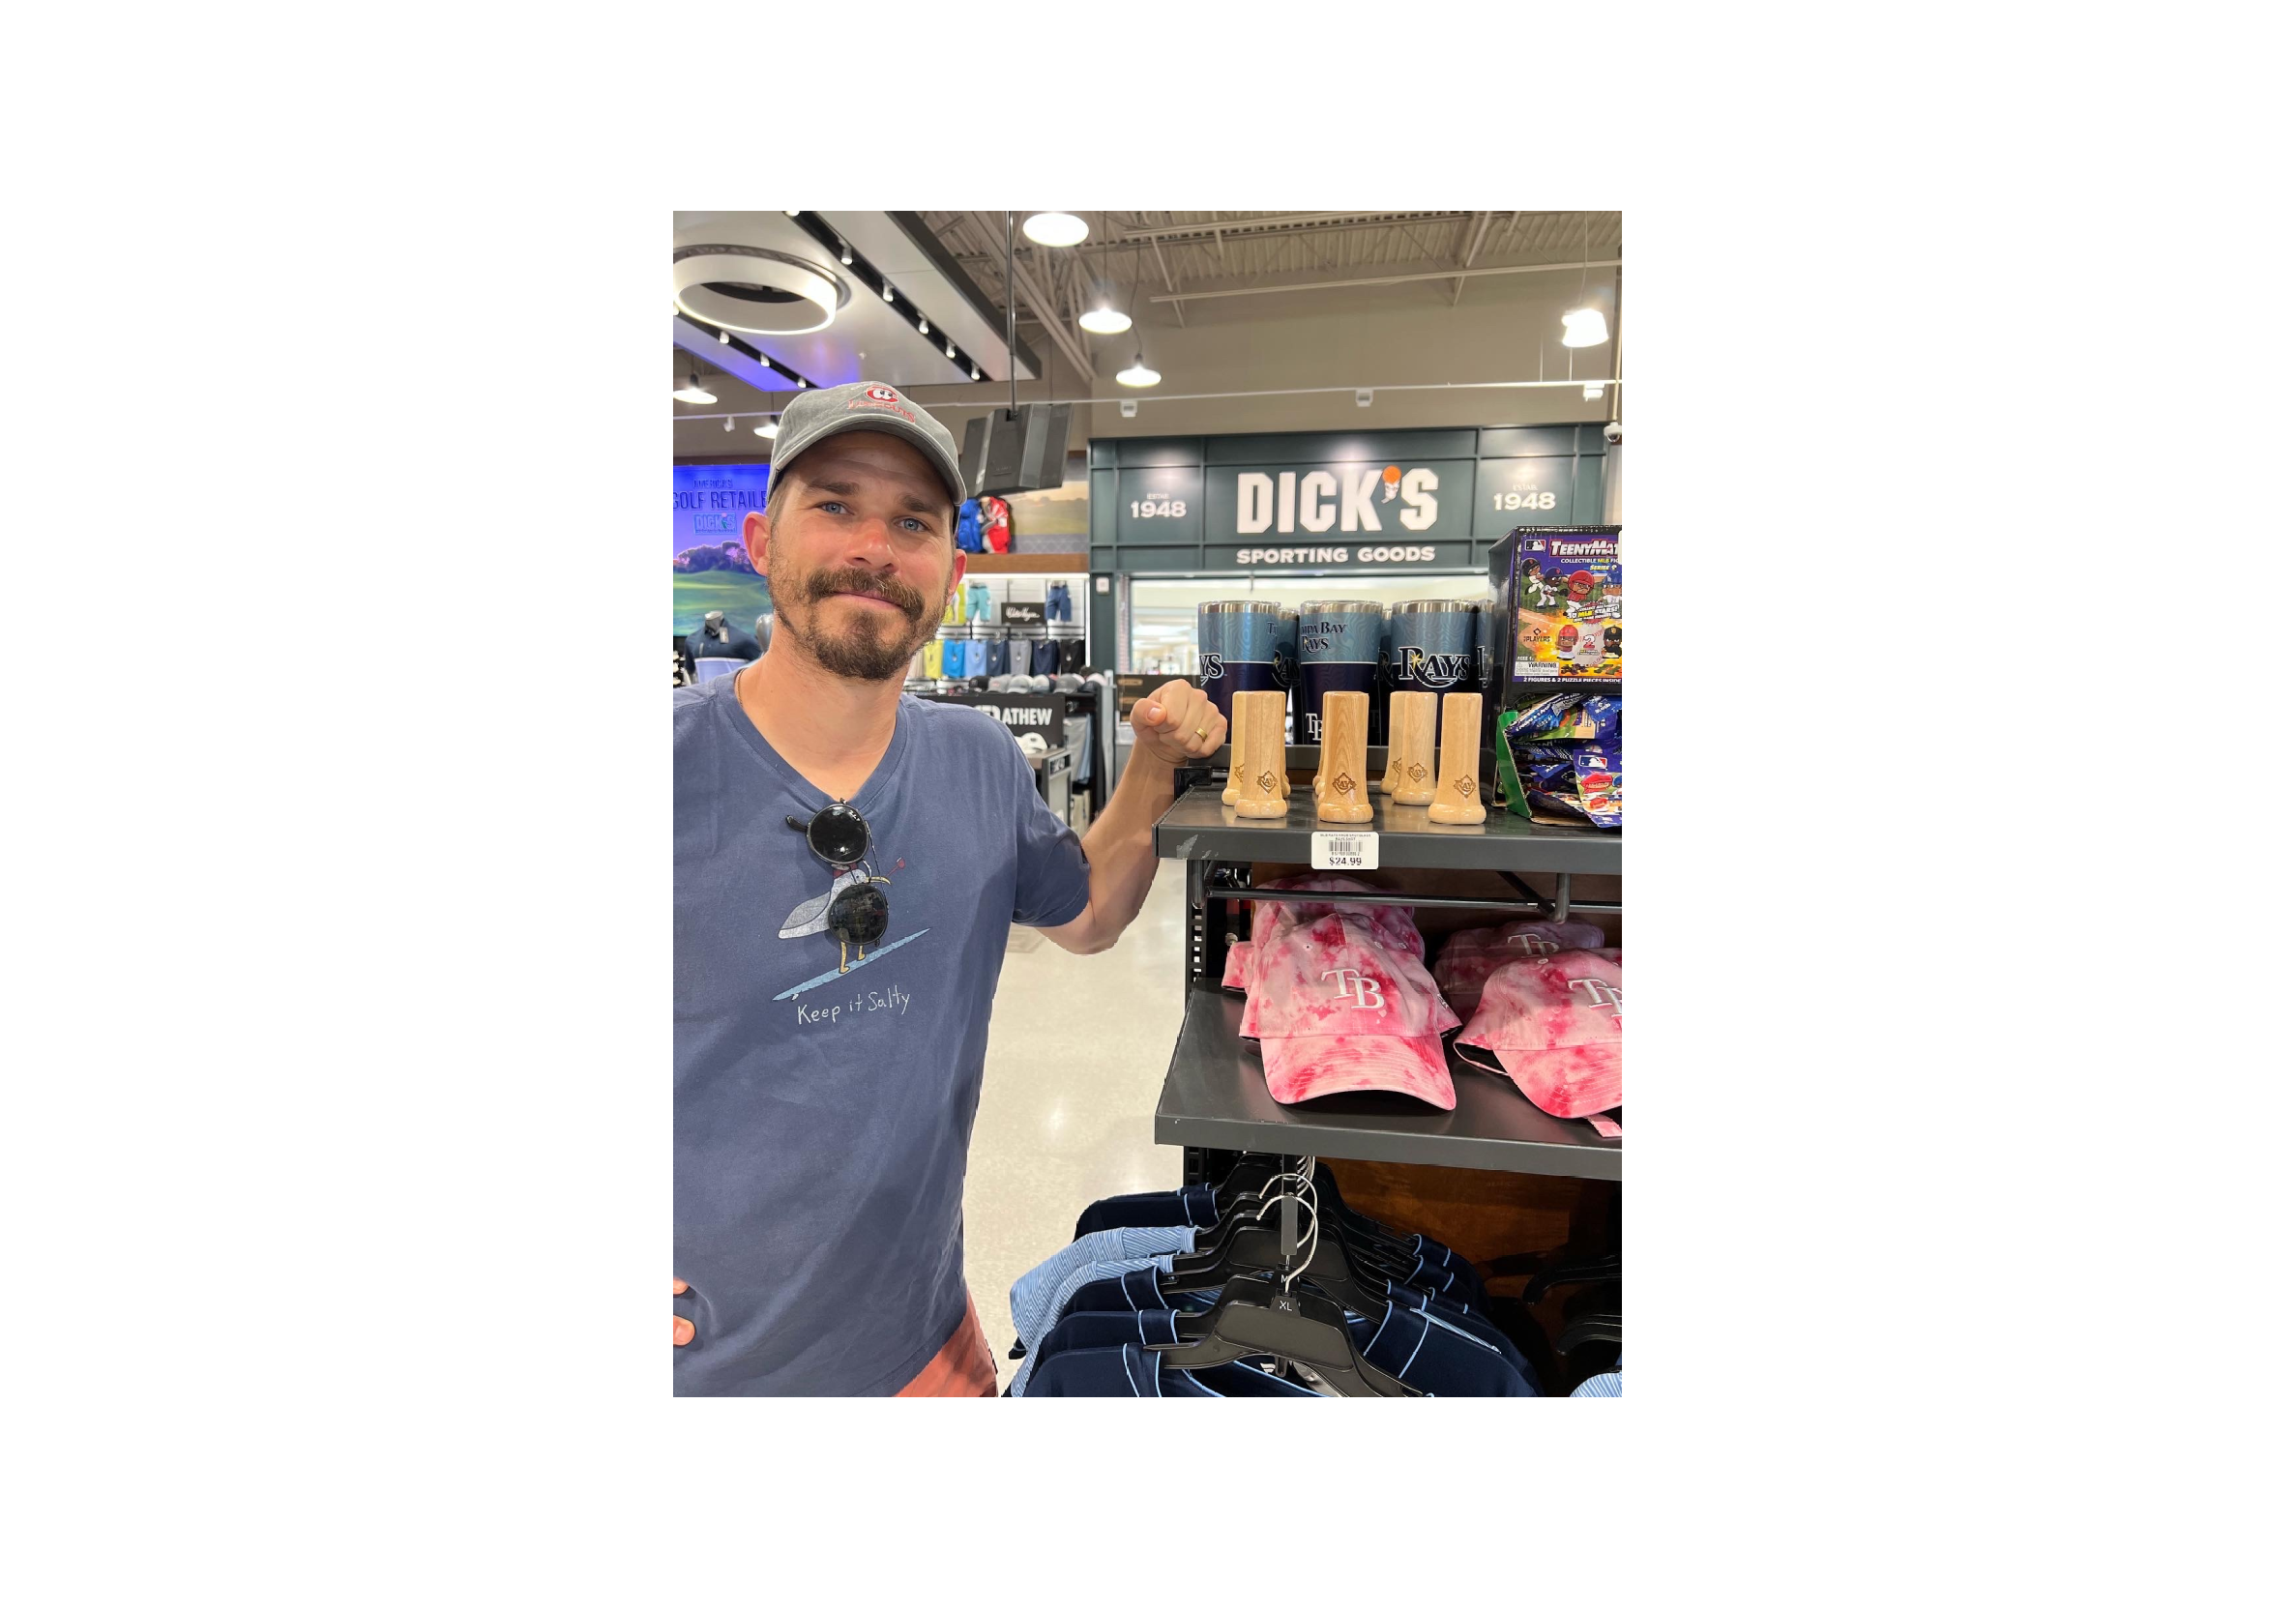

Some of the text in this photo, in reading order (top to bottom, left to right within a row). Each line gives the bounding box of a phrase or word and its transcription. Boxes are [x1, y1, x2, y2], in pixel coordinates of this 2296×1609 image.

[1131, 500, 1188, 518] 1948
[1236, 465, 1440, 534] DICK'S
[1493, 491, 1556, 511] 1948
[1236, 545, 1436, 565] SPORTING GOODS
[1577, 609, 1594, 619] MLB
[1320, 622, 1347, 634] BAY
[1302, 635, 1330, 654] RAYS
[1398, 645, 1471, 688] RAYS
[1329, 857, 1362, 866] $24.99
[1321, 968, 1385, 1009] TB
[798, 984, 910, 1025] Keep it Salty
[1279, 1300, 1293, 1312] XL
